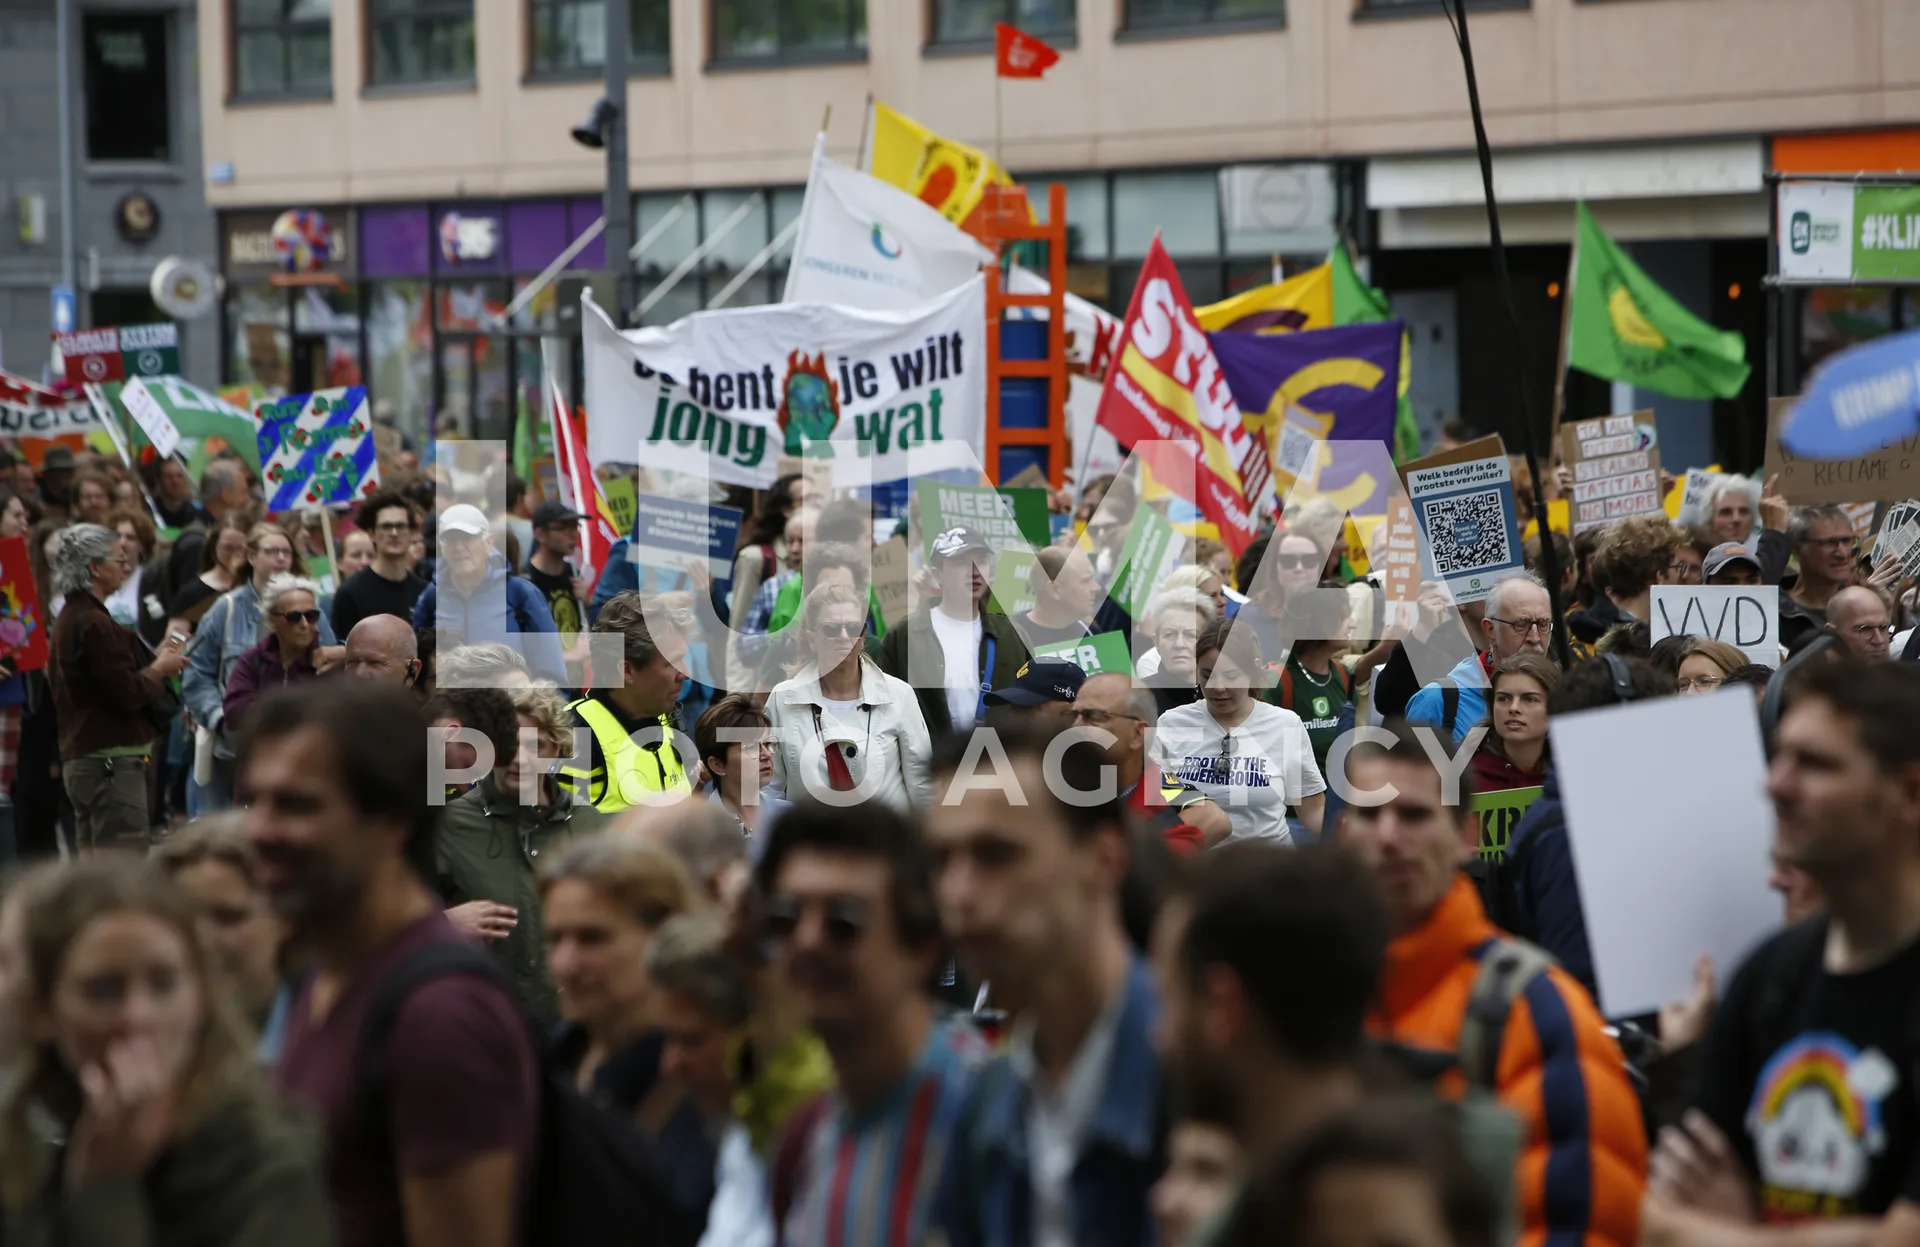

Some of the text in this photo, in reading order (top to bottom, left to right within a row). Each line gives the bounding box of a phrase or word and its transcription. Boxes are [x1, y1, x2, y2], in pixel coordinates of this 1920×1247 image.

[838, 356, 879, 406] je
[891, 331, 964, 391] wilt
[646, 386, 944, 467] jong wat
[1414, 469, 1504, 494] grootste vervuiler?
[1417, 462, 1498, 482] Welk bedrijf is de
[1814, 458, 1892, 487] RECLAME
[938, 487, 1017, 518] MEER
[1582, 494, 1655, 519] NO MORE
[1658, 596, 1768, 647] VVD
[1175, 766, 1272, 788] UNDERGROUND
[1243, 756, 1267, 773] THE
